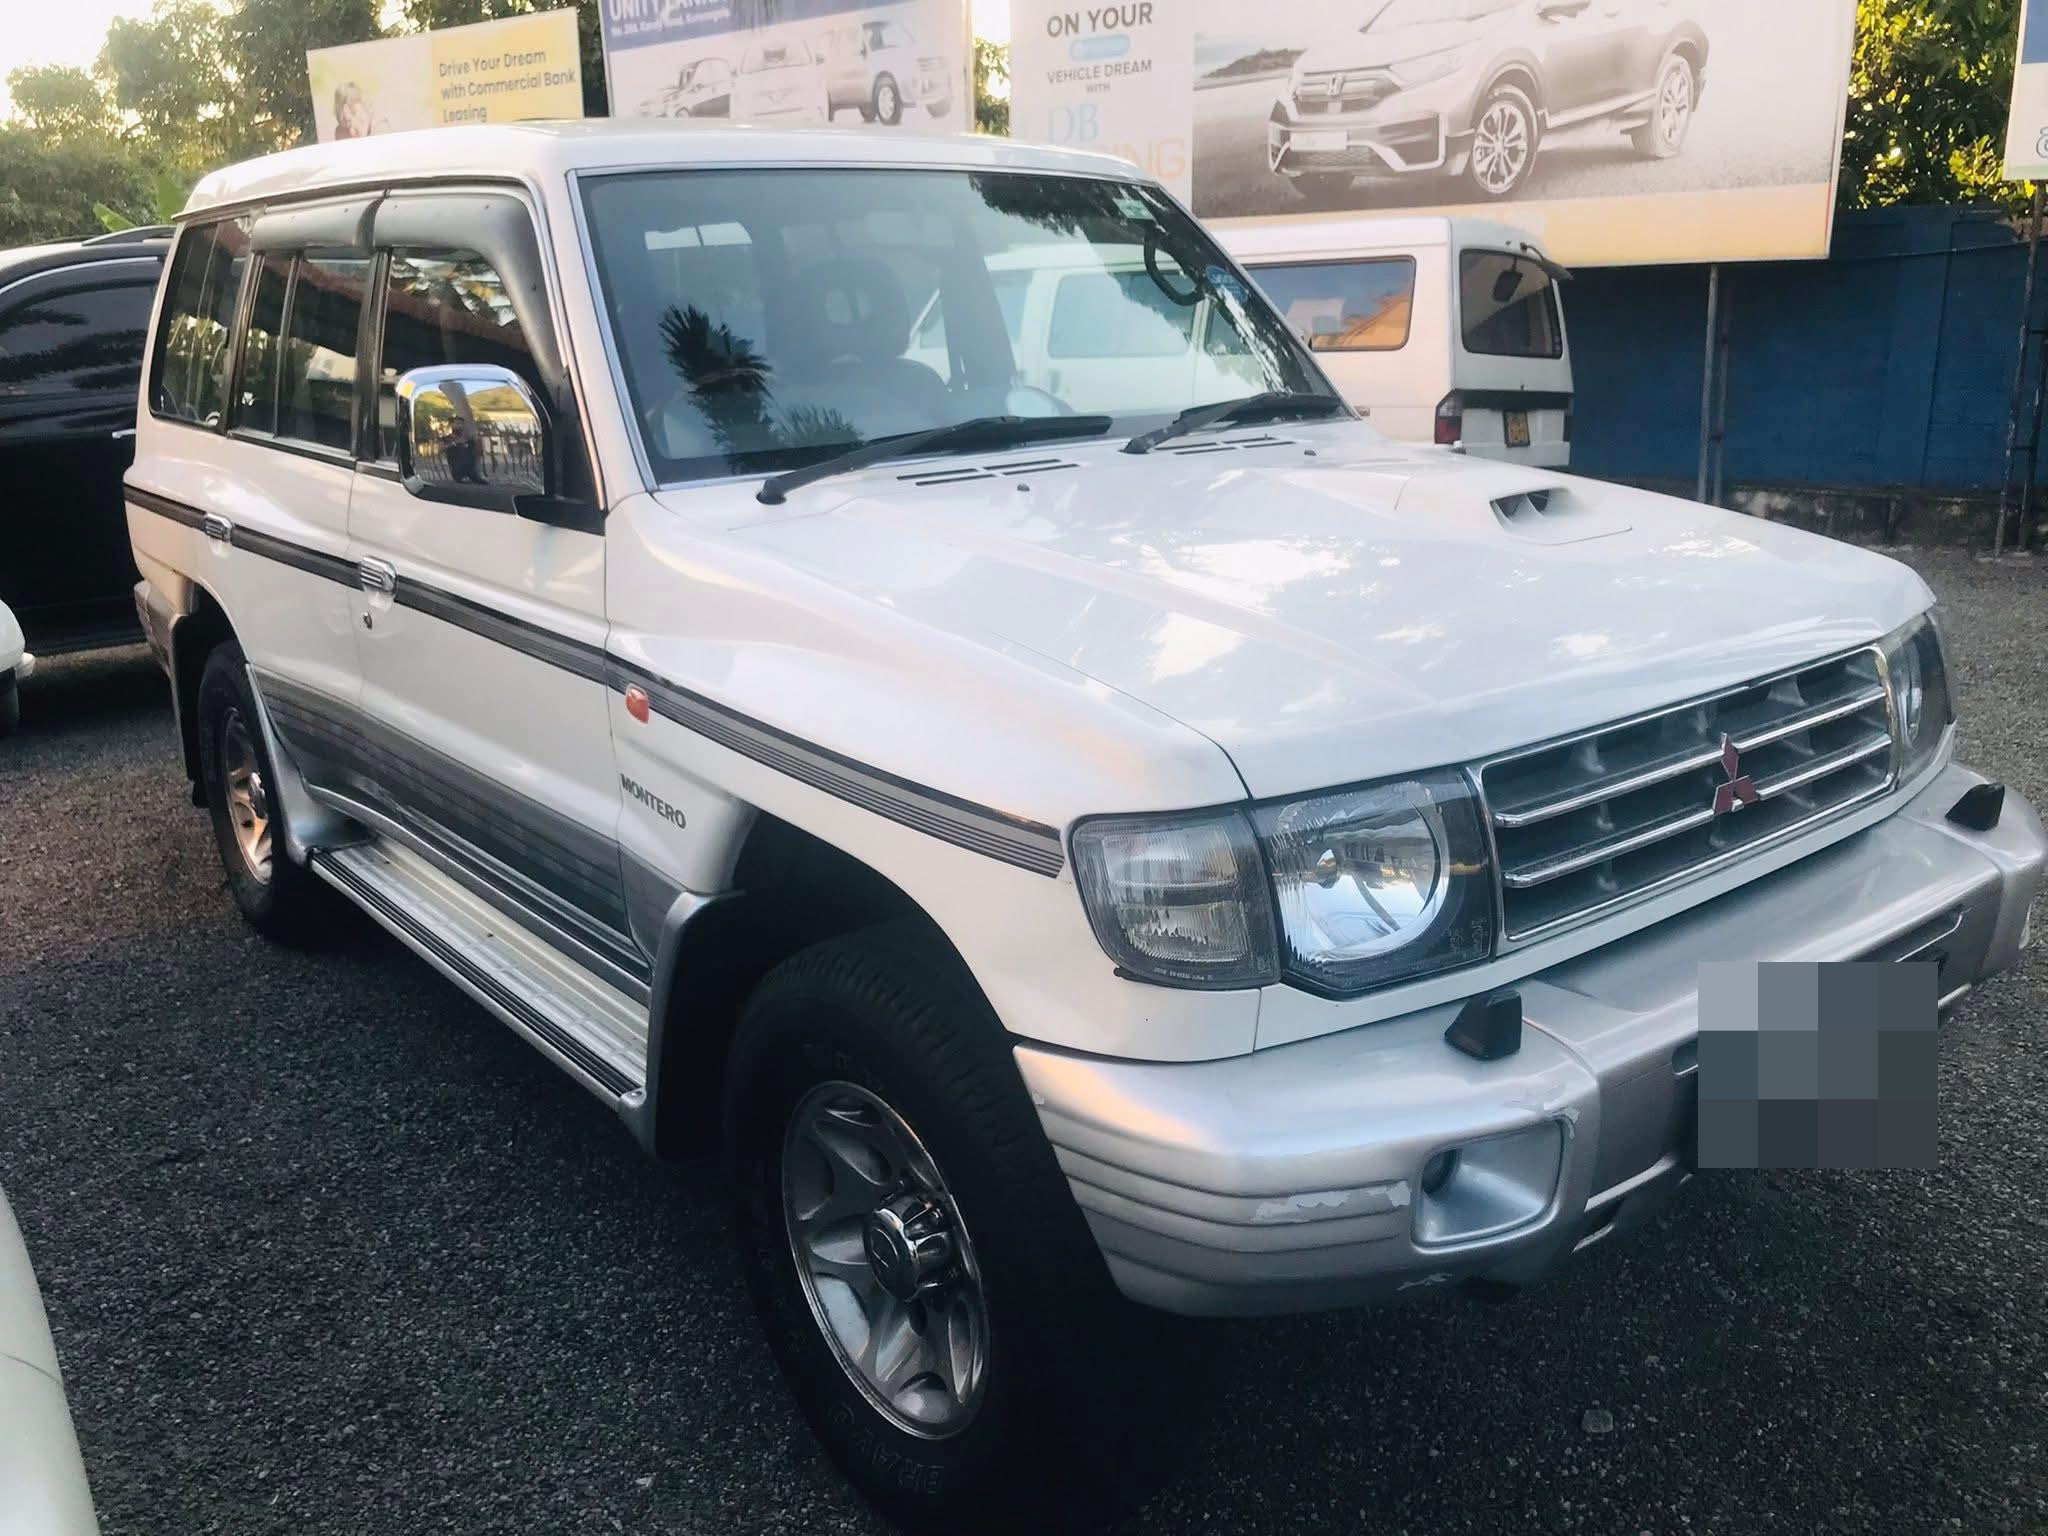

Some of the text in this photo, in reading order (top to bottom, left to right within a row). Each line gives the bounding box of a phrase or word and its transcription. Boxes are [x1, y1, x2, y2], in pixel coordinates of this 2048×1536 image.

[1047, 2, 1153, 38] ON YOUR
[439, 51, 546, 77] Drive Your Dream
[1047, 59, 1153, 84] VEHICLE DREAM
[441, 68, 577, 100] with Commercial Bank
[1086, 83, 1111, 94] WITH
[443, 104, 487, 123] Leasing
[620, 773, 687, 829] MONTERO
